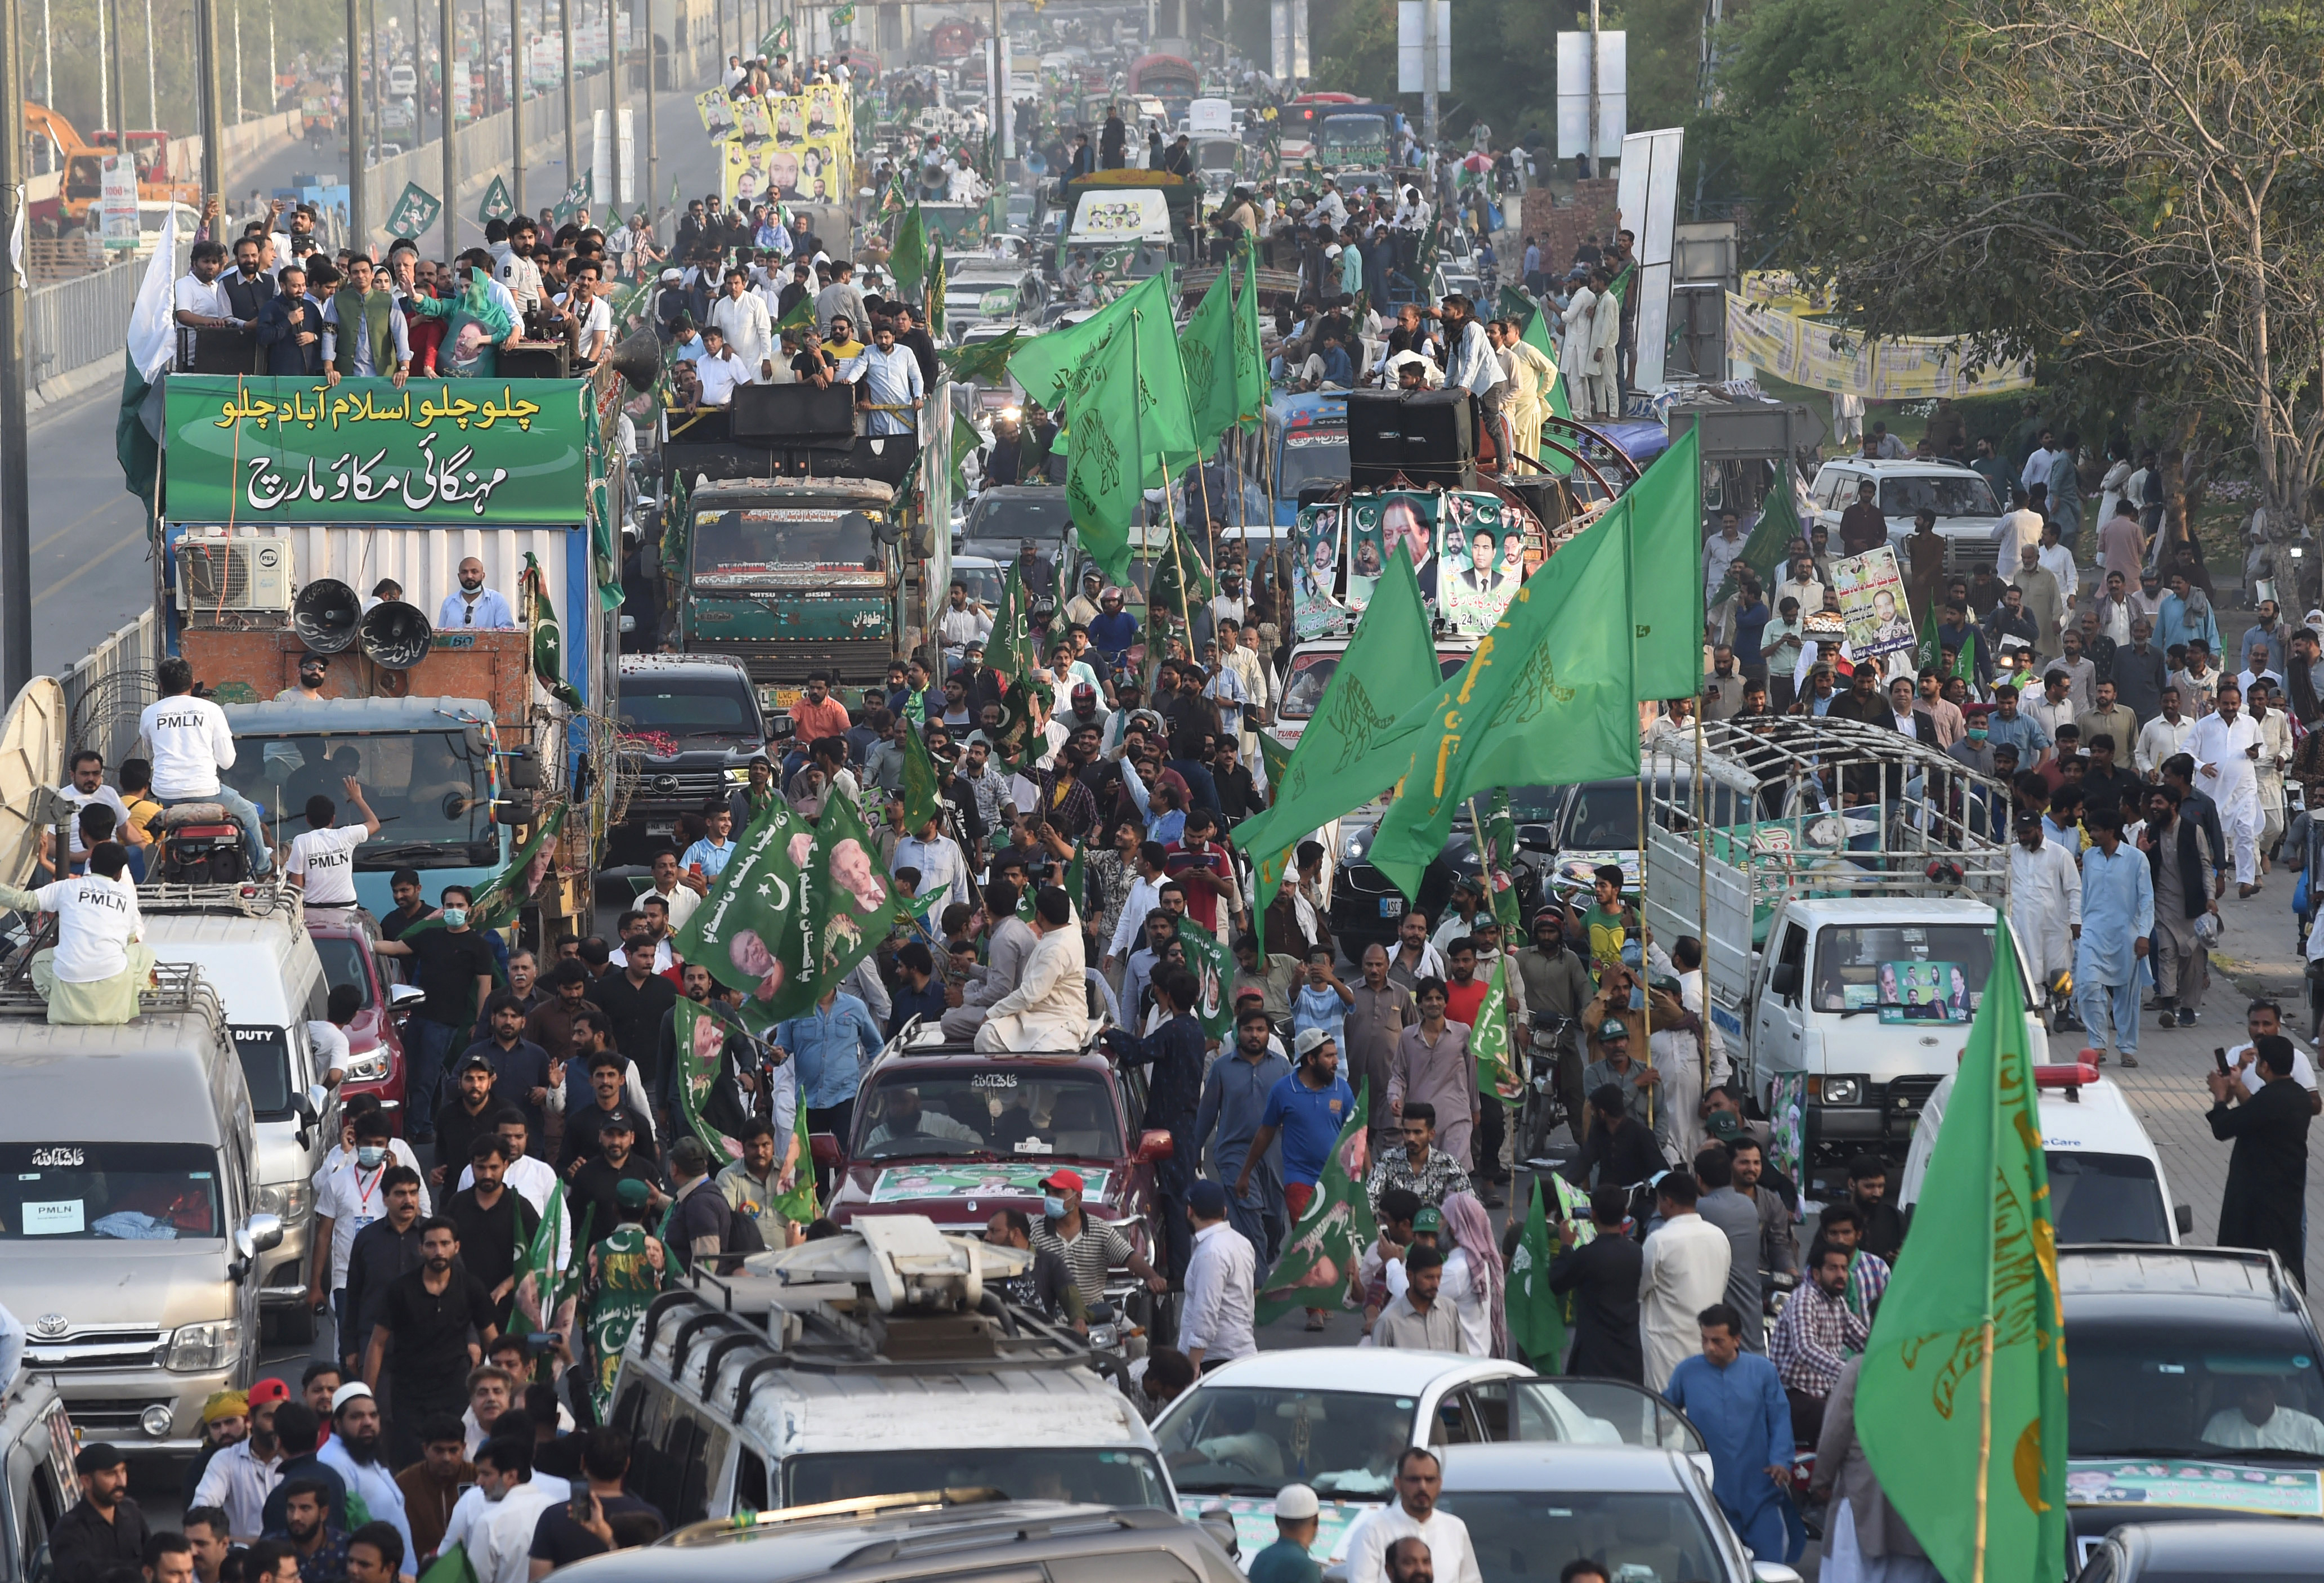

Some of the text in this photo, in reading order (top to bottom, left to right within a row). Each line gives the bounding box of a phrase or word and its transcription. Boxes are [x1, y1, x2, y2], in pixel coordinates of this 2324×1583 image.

[504, 266, 511, 278] 8
[213, 384, 540, 431] چلو چلو اسلام آباد چلو
[247, 432, 510, 516] مہنگائی مکاؤ مارچ
[852, 611, 881, 628] طوفان
[1462, 614, 1472, 625] 24
[157, 715, 204, 730] PMLN
[309, 852, 348, 869] PMLN
[107, 889, 127, 899] MEDIA
[78, 891, 126, 913] PMLN
[235, 1030, 274, 1041] DUTY
[38, 1206, 71, 1214] PMLN
